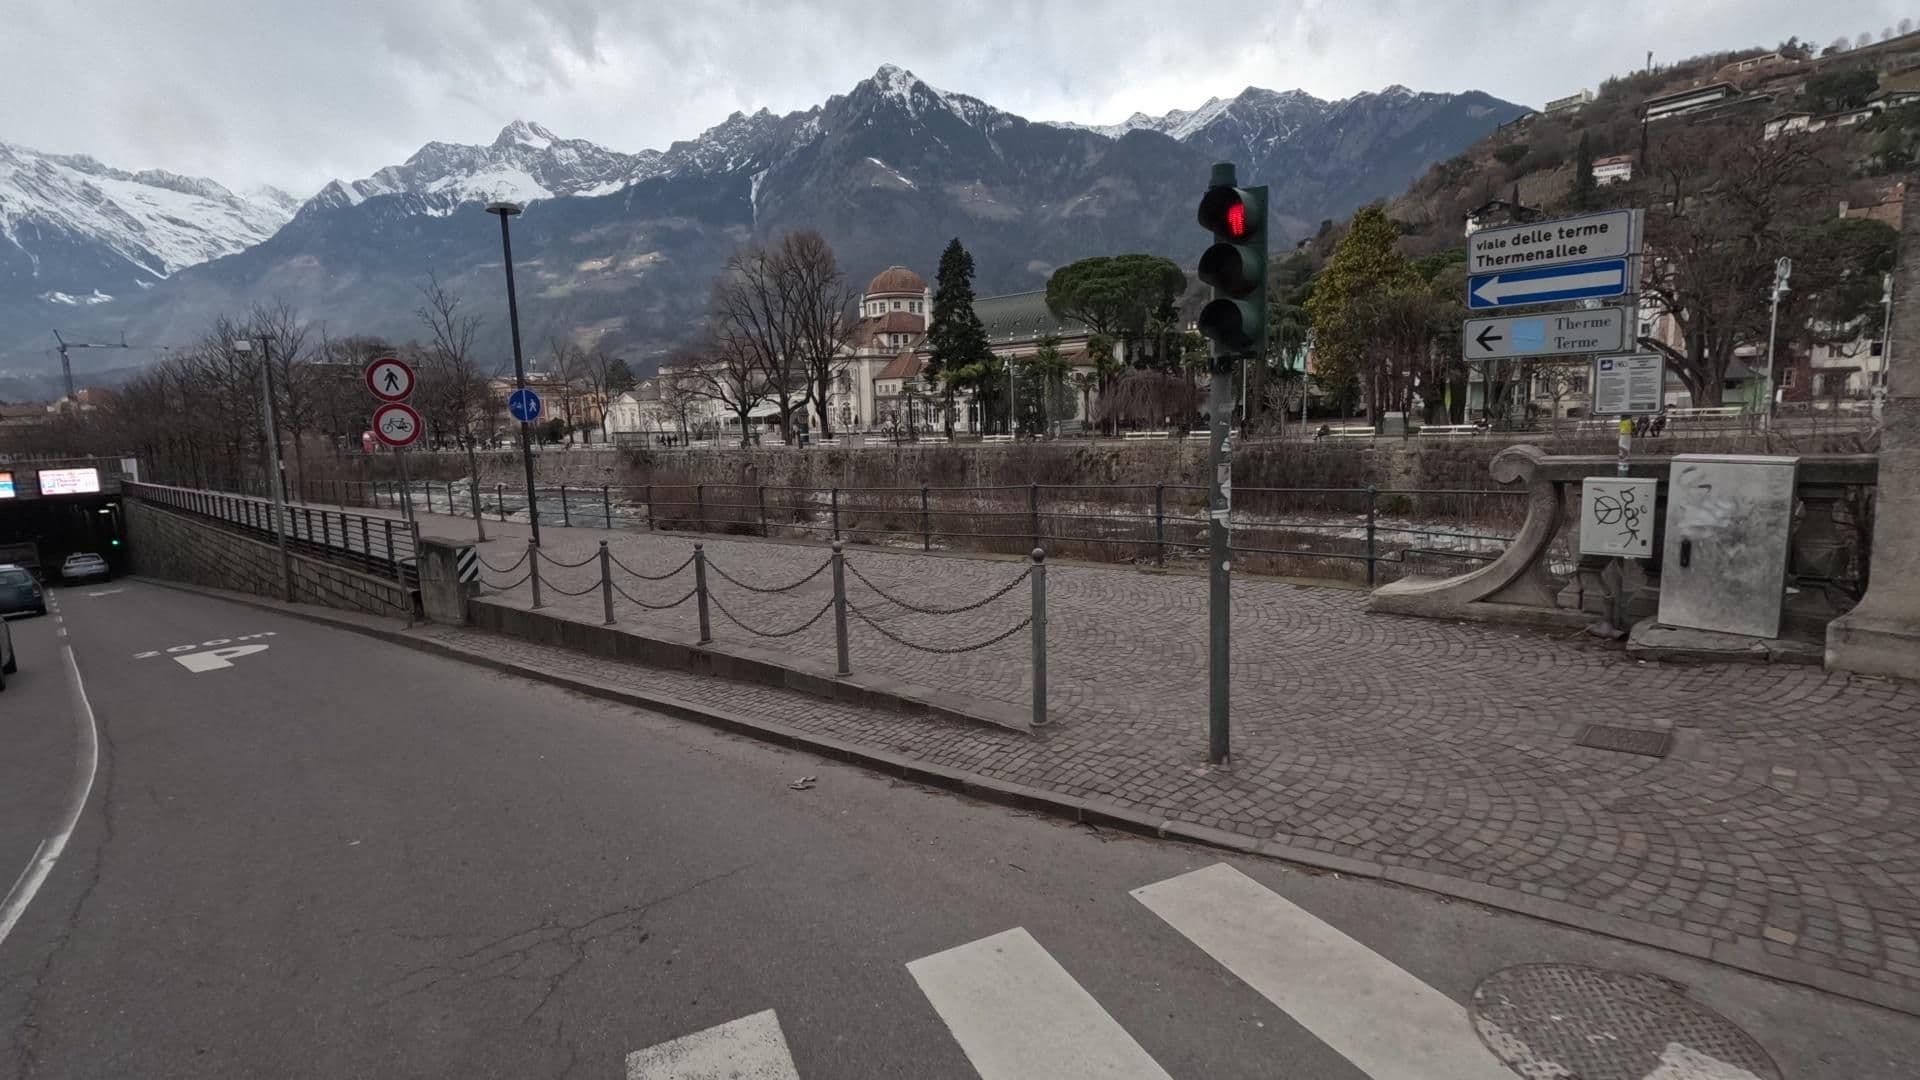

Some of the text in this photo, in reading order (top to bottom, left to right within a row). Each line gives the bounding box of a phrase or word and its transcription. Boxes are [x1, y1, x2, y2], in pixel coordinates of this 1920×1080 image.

[1476, 223, 1609, 251] viale delle terme
[1476, 243, 1588, 268] Thermenallee
[1555, 317, 1612, 332] Therme
[1554, 336, 1599, 350] Terme
